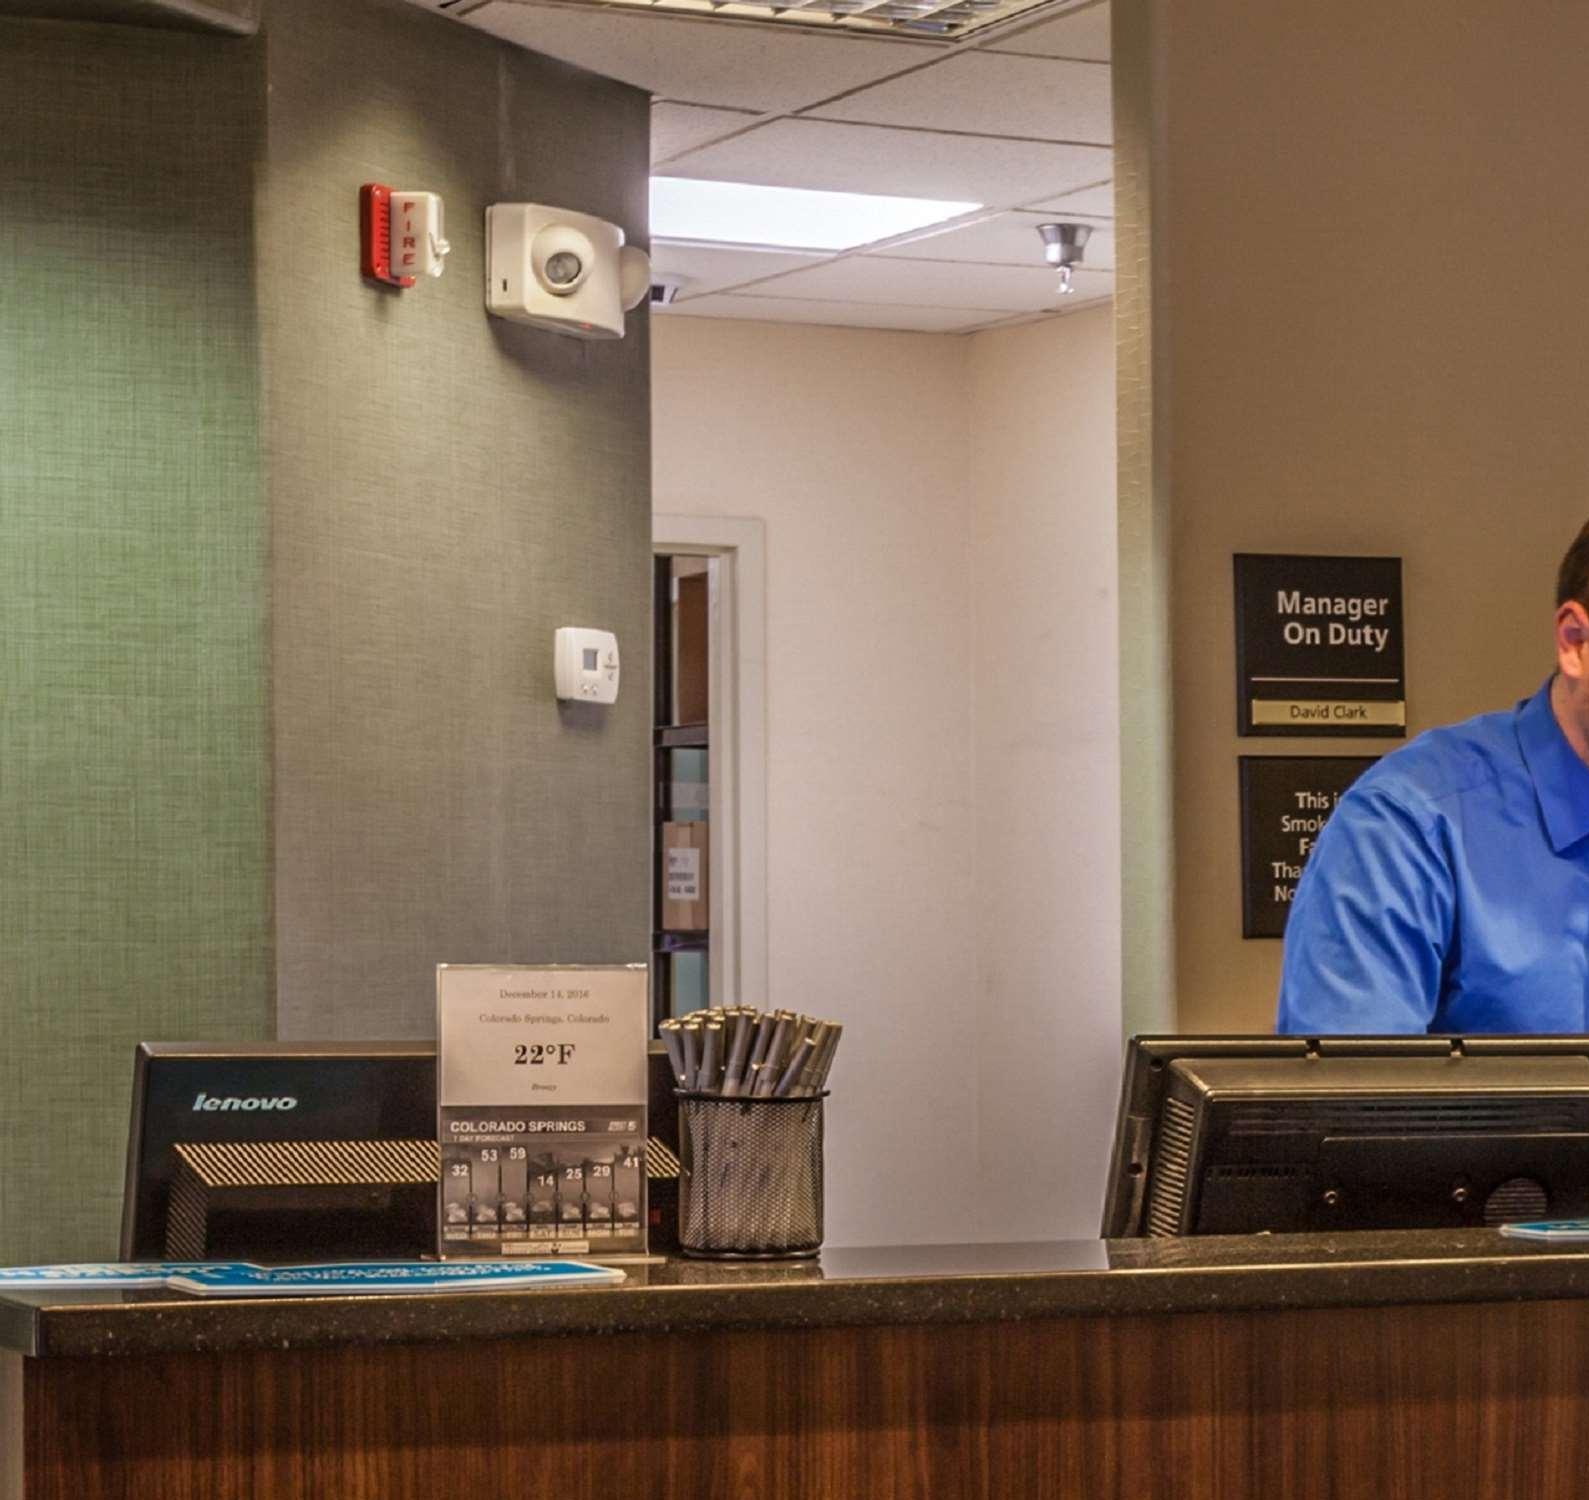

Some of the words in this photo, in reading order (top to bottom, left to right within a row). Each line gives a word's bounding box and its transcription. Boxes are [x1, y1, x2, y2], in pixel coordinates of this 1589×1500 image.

[402, 202, 416, 265] FIRE
[1277, 590, 1388, 620] Manager
[1284, 623, 1321, 645] On
[1329, 622, 1389, 652] Duty
[1290, 704, 1330, 719] David
[1333, 704, 1367, 720] Clark
[1295, 792, 1329, 809] This
[499, 989, 548, 999] December
[479, 1013, 522, 1023] Colorado
[567, 1013, 610, 1023] Colorado
[514, 1043, 576, 1065] 22°F
[192, 1093, 298, 1112] lenovo
[450, 1121, 526, 1133] COLORADO
[528, 1121, 586, 1132] SPRINGS
[481, 1149, 498, 1161] 53
[509, 1147, 526, 1159] 59
[623, 1157, 639, 1168] 41
[452, 1165, 469, 1176] 32
[566, 1168, 582, 1179] 25
[593, 1165, 610, 1177] 29
[537, 1175, 554, 1186] 14
